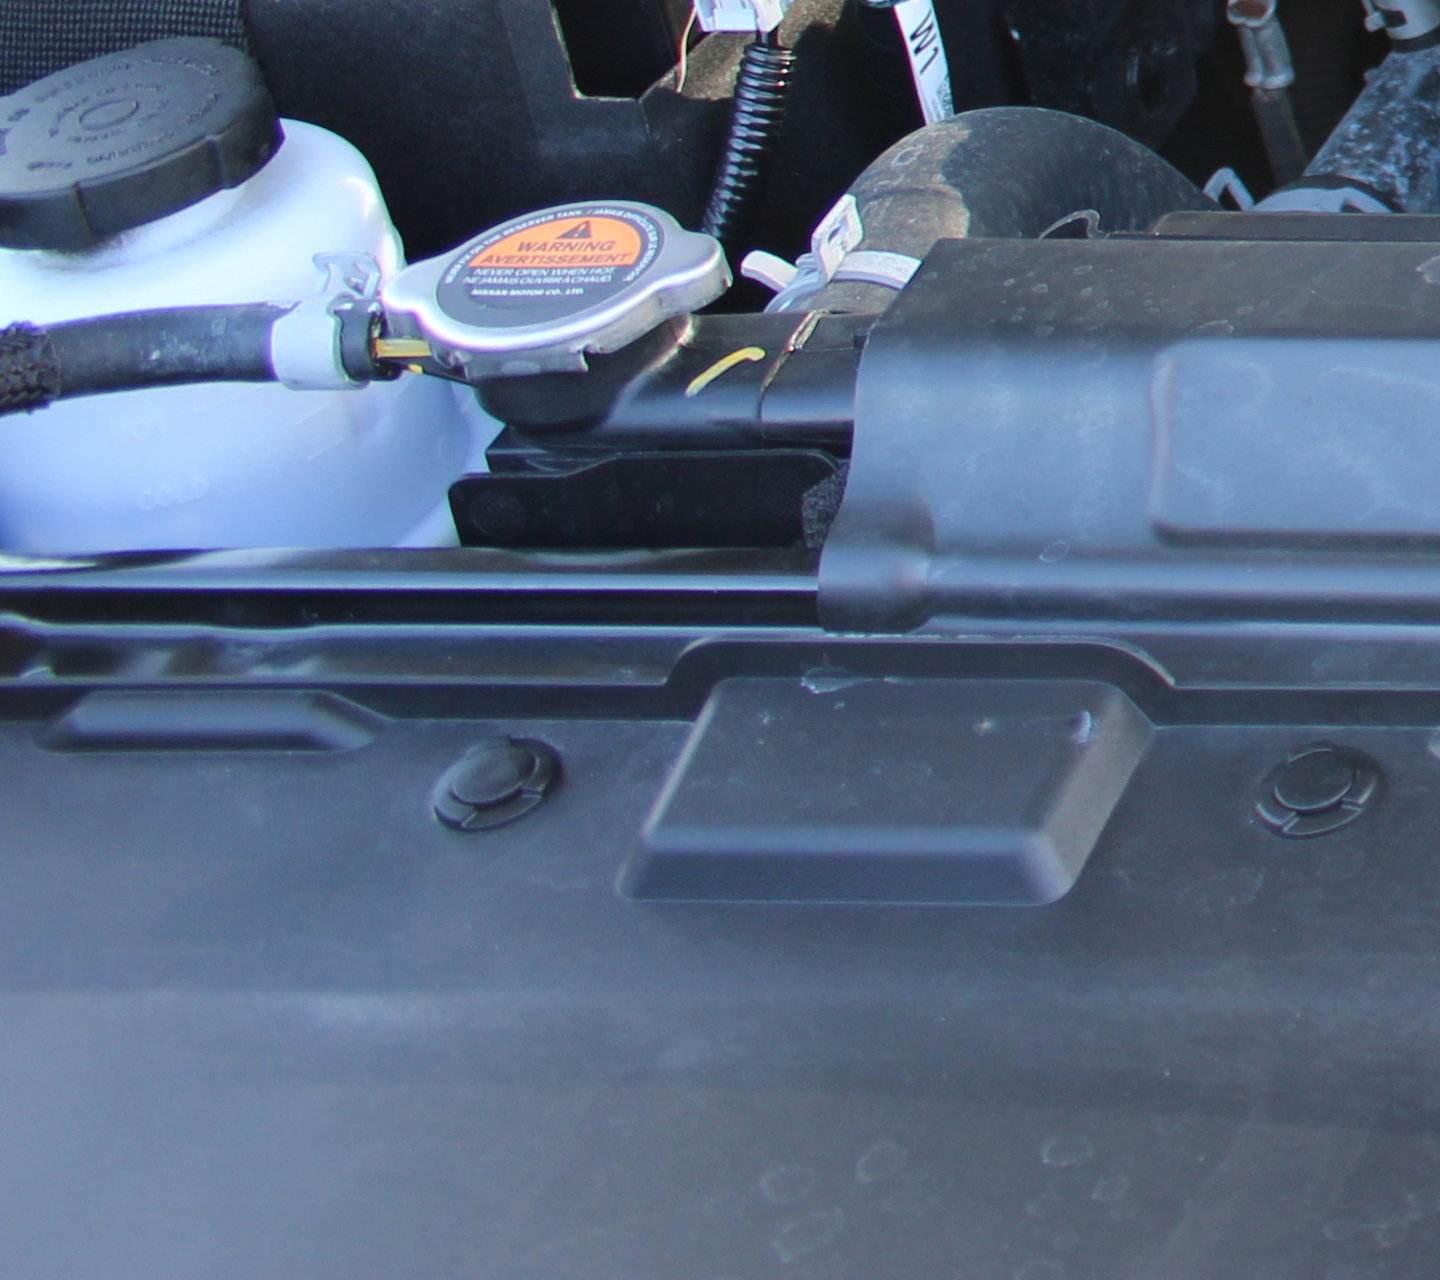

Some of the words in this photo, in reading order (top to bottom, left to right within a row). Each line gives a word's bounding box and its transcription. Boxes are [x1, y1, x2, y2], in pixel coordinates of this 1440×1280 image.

[503, 214, 554, 236] RESERVER
[557, 209, 583, 219] TANK
[517, 240, 616, 253] WARNING
[480, 252, 632, 265] AVERTISSEMENT
[473, 267, 514, 276] NEVER
[515, 267, 549, 276] OPEN
[550, 267, 588, 276] WHEN
[463, 276, 478, 284] NE
[477, 276, 519, 285] JAMAIS
[519, 276, 560, 284] OUVRIR
[470, 288, 508, 296] NISSAN
[509, 288, 544, 296] MOTOR
